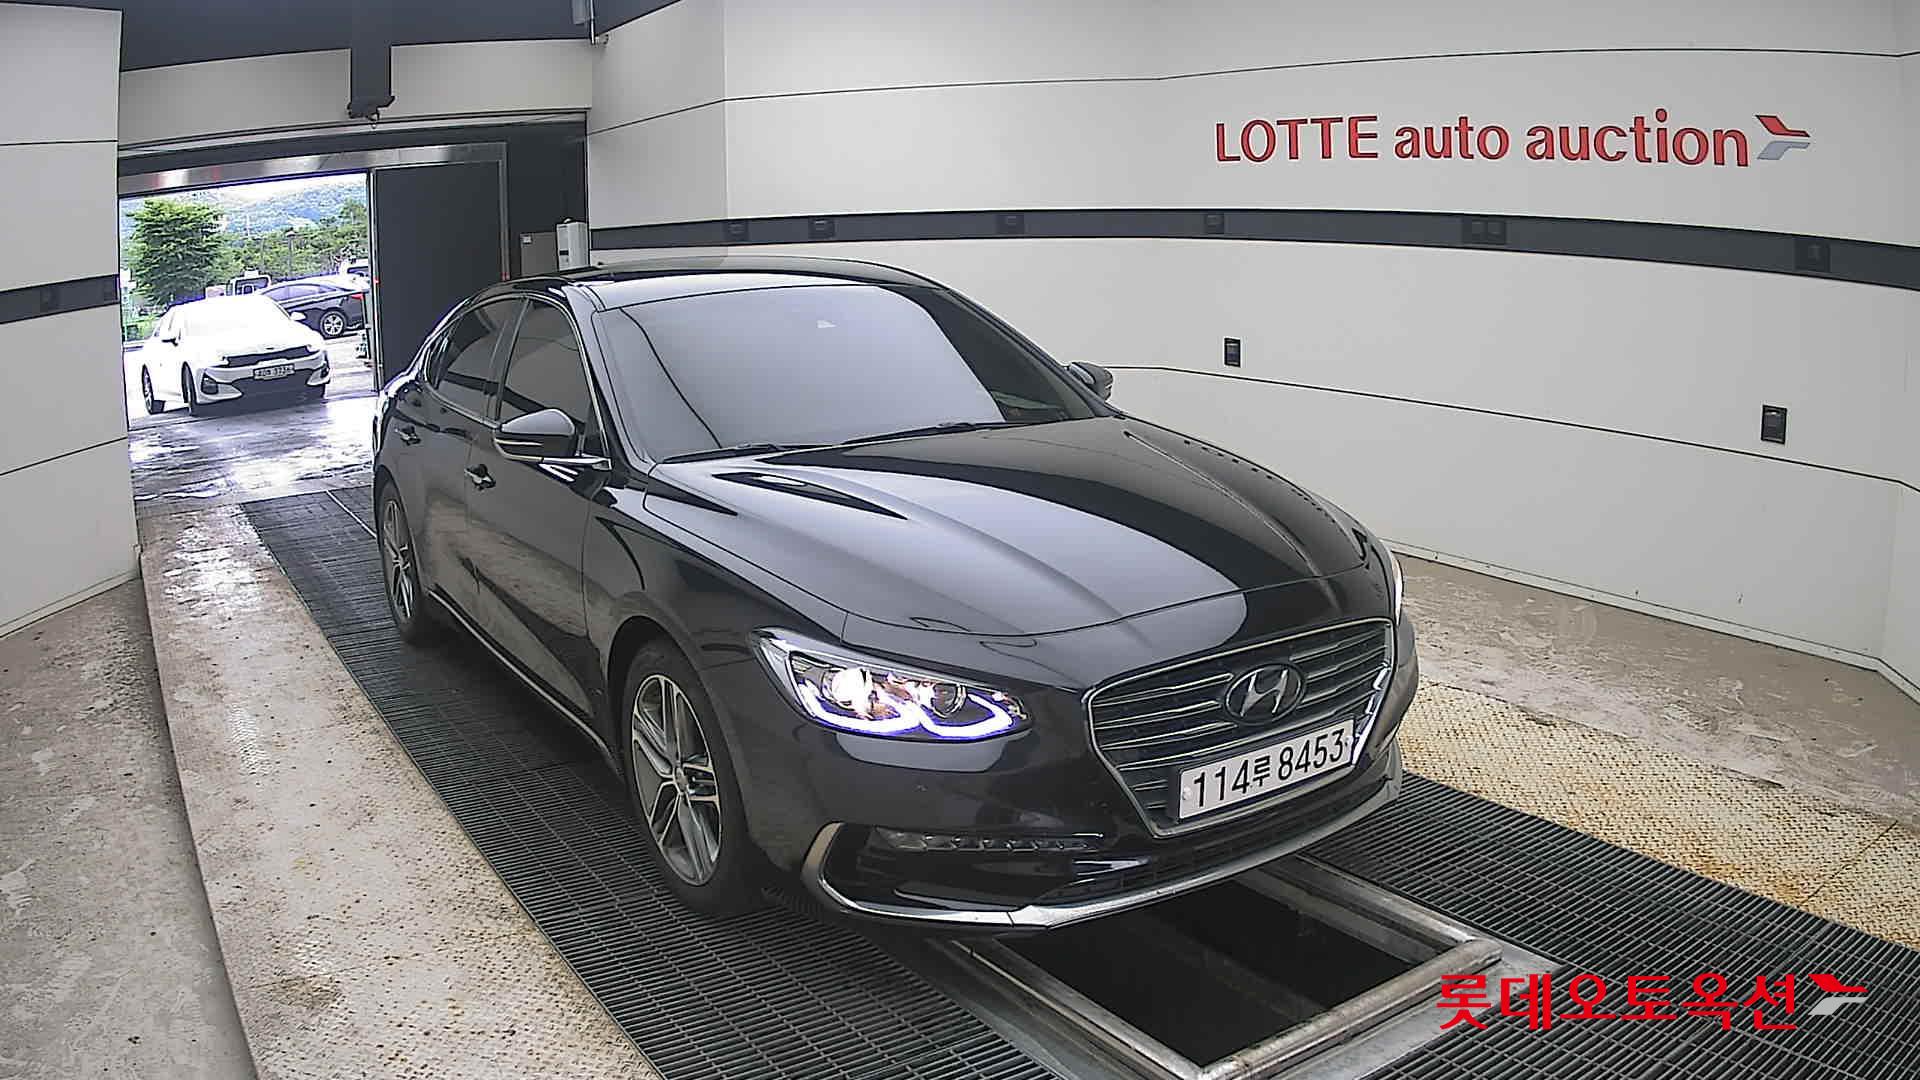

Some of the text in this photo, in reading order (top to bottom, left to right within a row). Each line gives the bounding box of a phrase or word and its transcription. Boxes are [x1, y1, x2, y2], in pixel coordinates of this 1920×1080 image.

[1216, 108, 1749, 167] LOTTE auto auction
[1278, 728, 1346, 781] 8453
